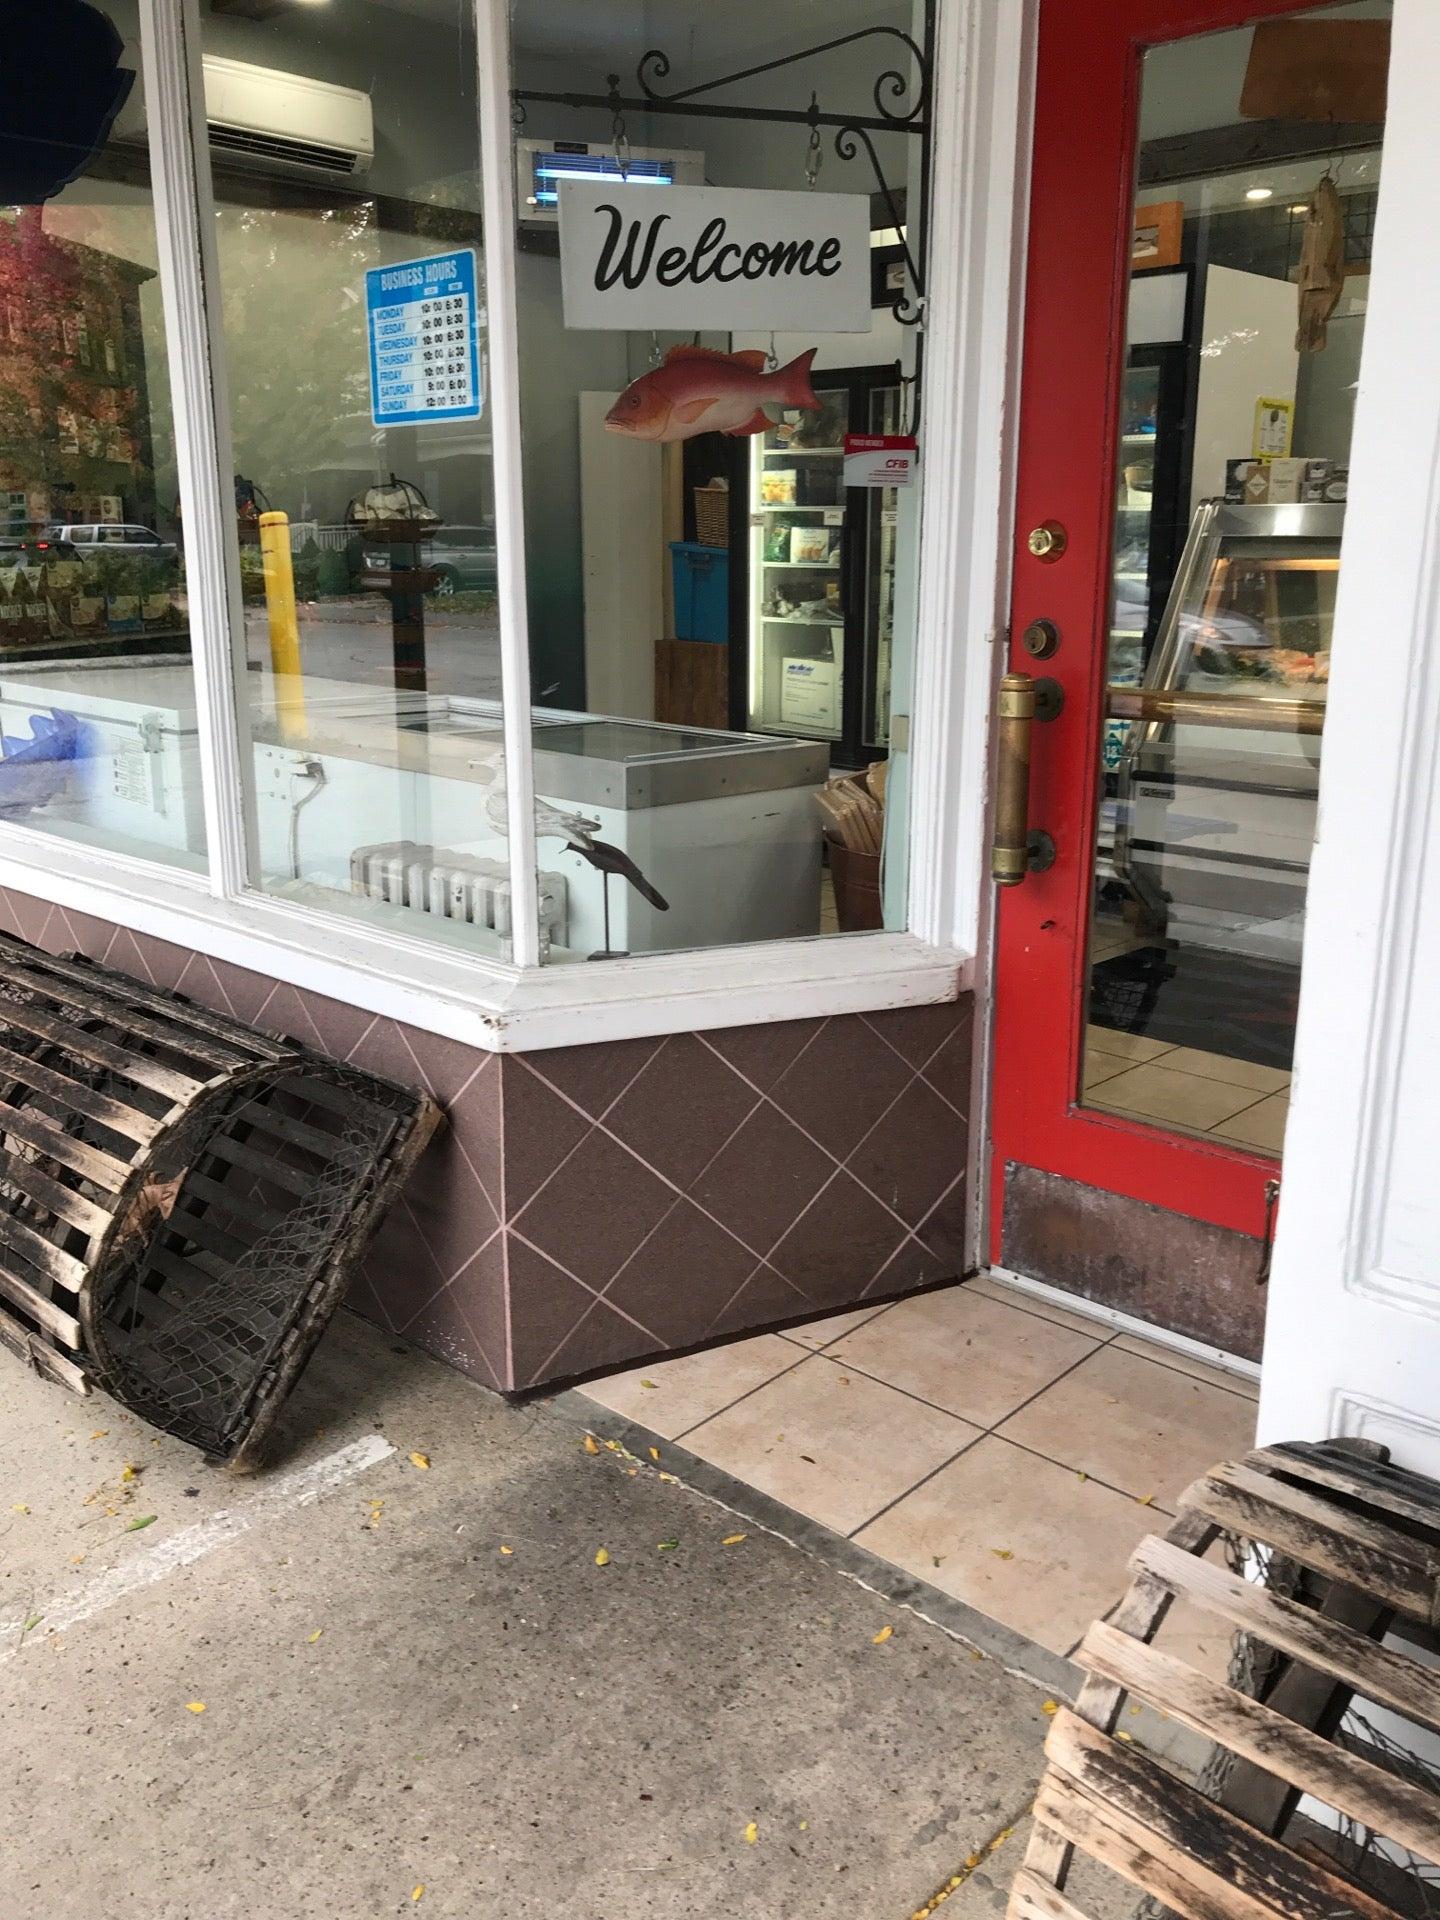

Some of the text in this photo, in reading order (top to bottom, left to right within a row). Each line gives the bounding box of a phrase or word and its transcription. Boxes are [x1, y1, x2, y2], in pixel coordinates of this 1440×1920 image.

[594, 204, 842, 291] Welcome
[381, 260, 457, 291] BUSINESS HOURS
[376, 307, 404, 320] MONDAY
[378, 322, 405, 335] TUESDAY
[379, 337, 417, 350] WEDNESDAY
[379, 353, 412, 366] THURSDAY
[380, 370, 402, 381] FRIDAY
[381, 384, 414, 397] SATURDAY
[381, 400, 407, 411] SUNDAY
[886, 459, 909, 469] CFIB
